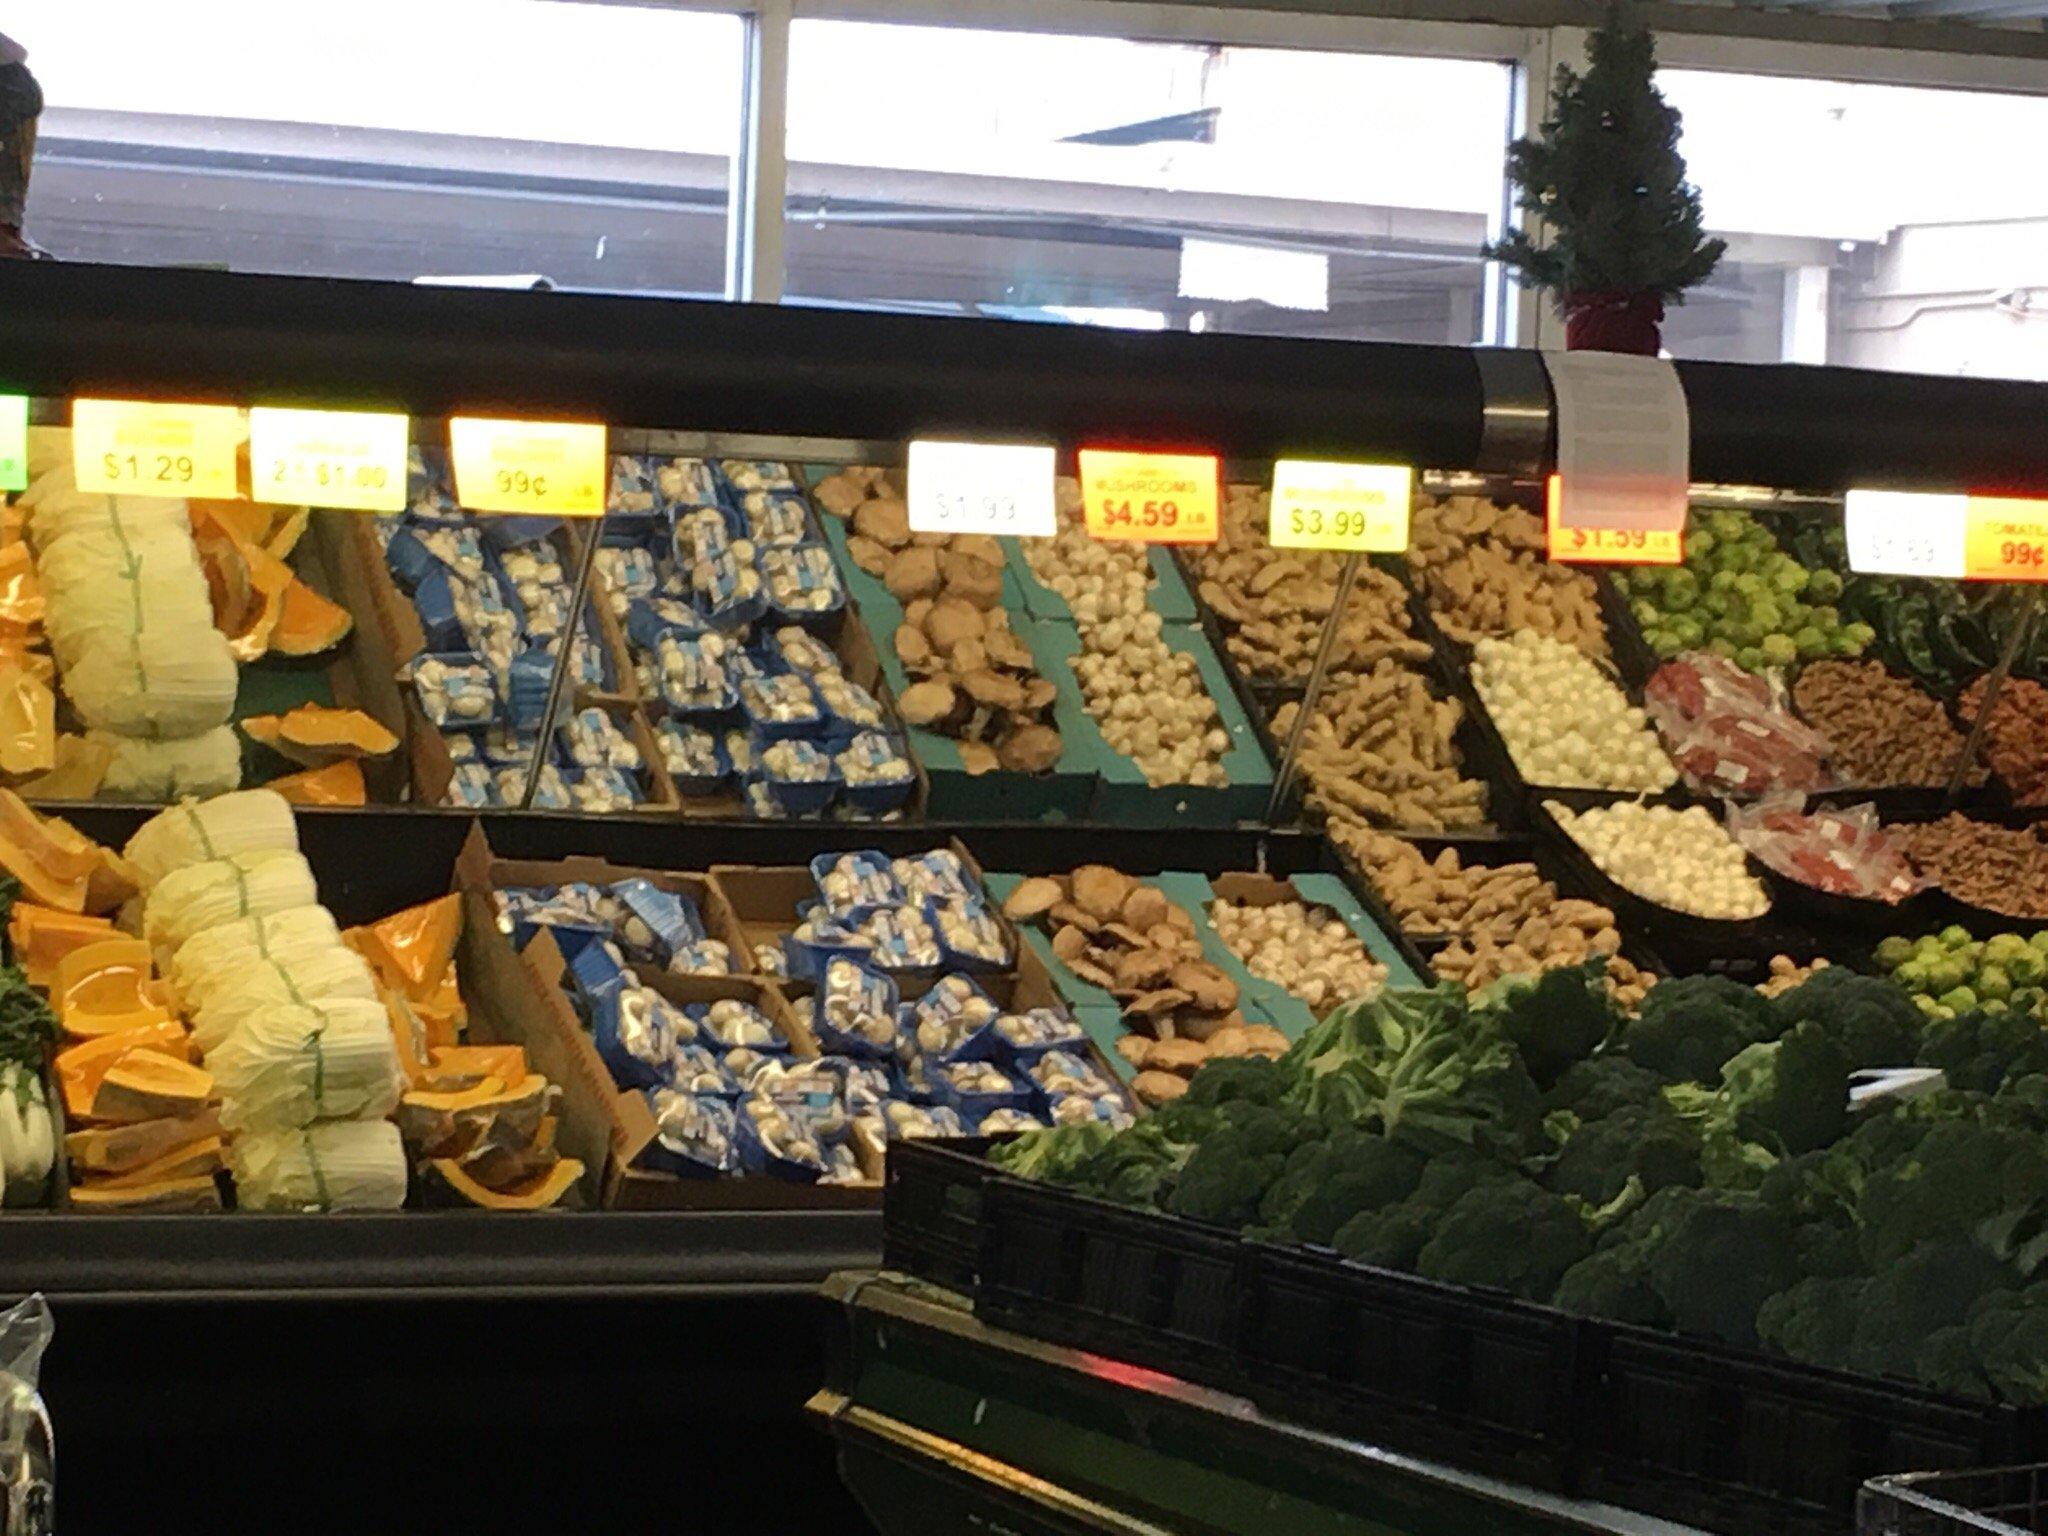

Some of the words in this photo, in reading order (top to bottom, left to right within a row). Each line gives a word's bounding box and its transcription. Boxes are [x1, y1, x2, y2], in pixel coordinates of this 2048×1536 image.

[103, 452, 194, 483] $1.29
[497, 470, 548, 500] 99¢
[1102, 498, 1179, 527] $4.59
[1291, 508, 1366, 537] $3.99
[2000, 540, 2045, 567] 99¢
